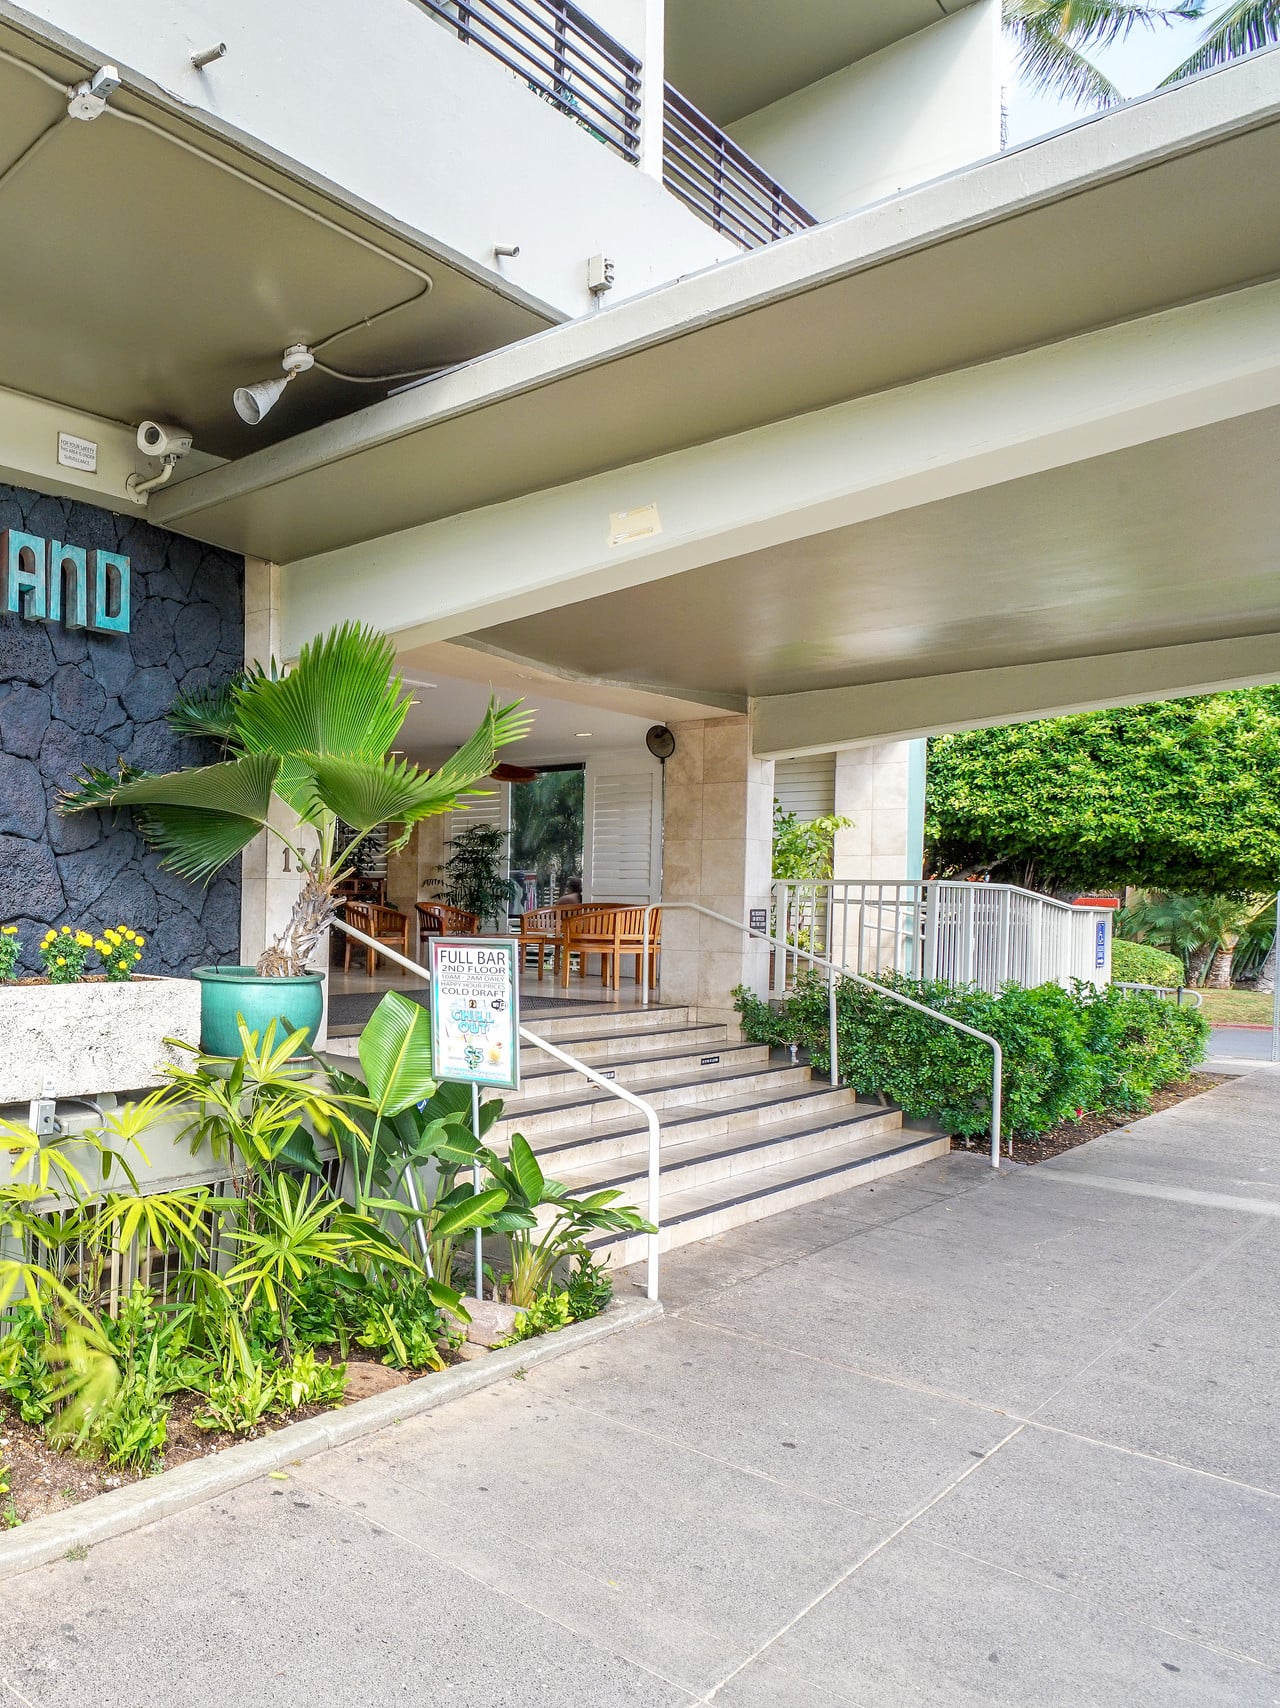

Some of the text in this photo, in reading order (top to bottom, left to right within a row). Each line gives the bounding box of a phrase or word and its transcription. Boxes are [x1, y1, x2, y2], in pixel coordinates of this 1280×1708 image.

[441, 950, 505, 965] FULL BAR
[468, 966, 506, 974] FLOOR
[441, 987, 506, 998] COLD DRAFT
